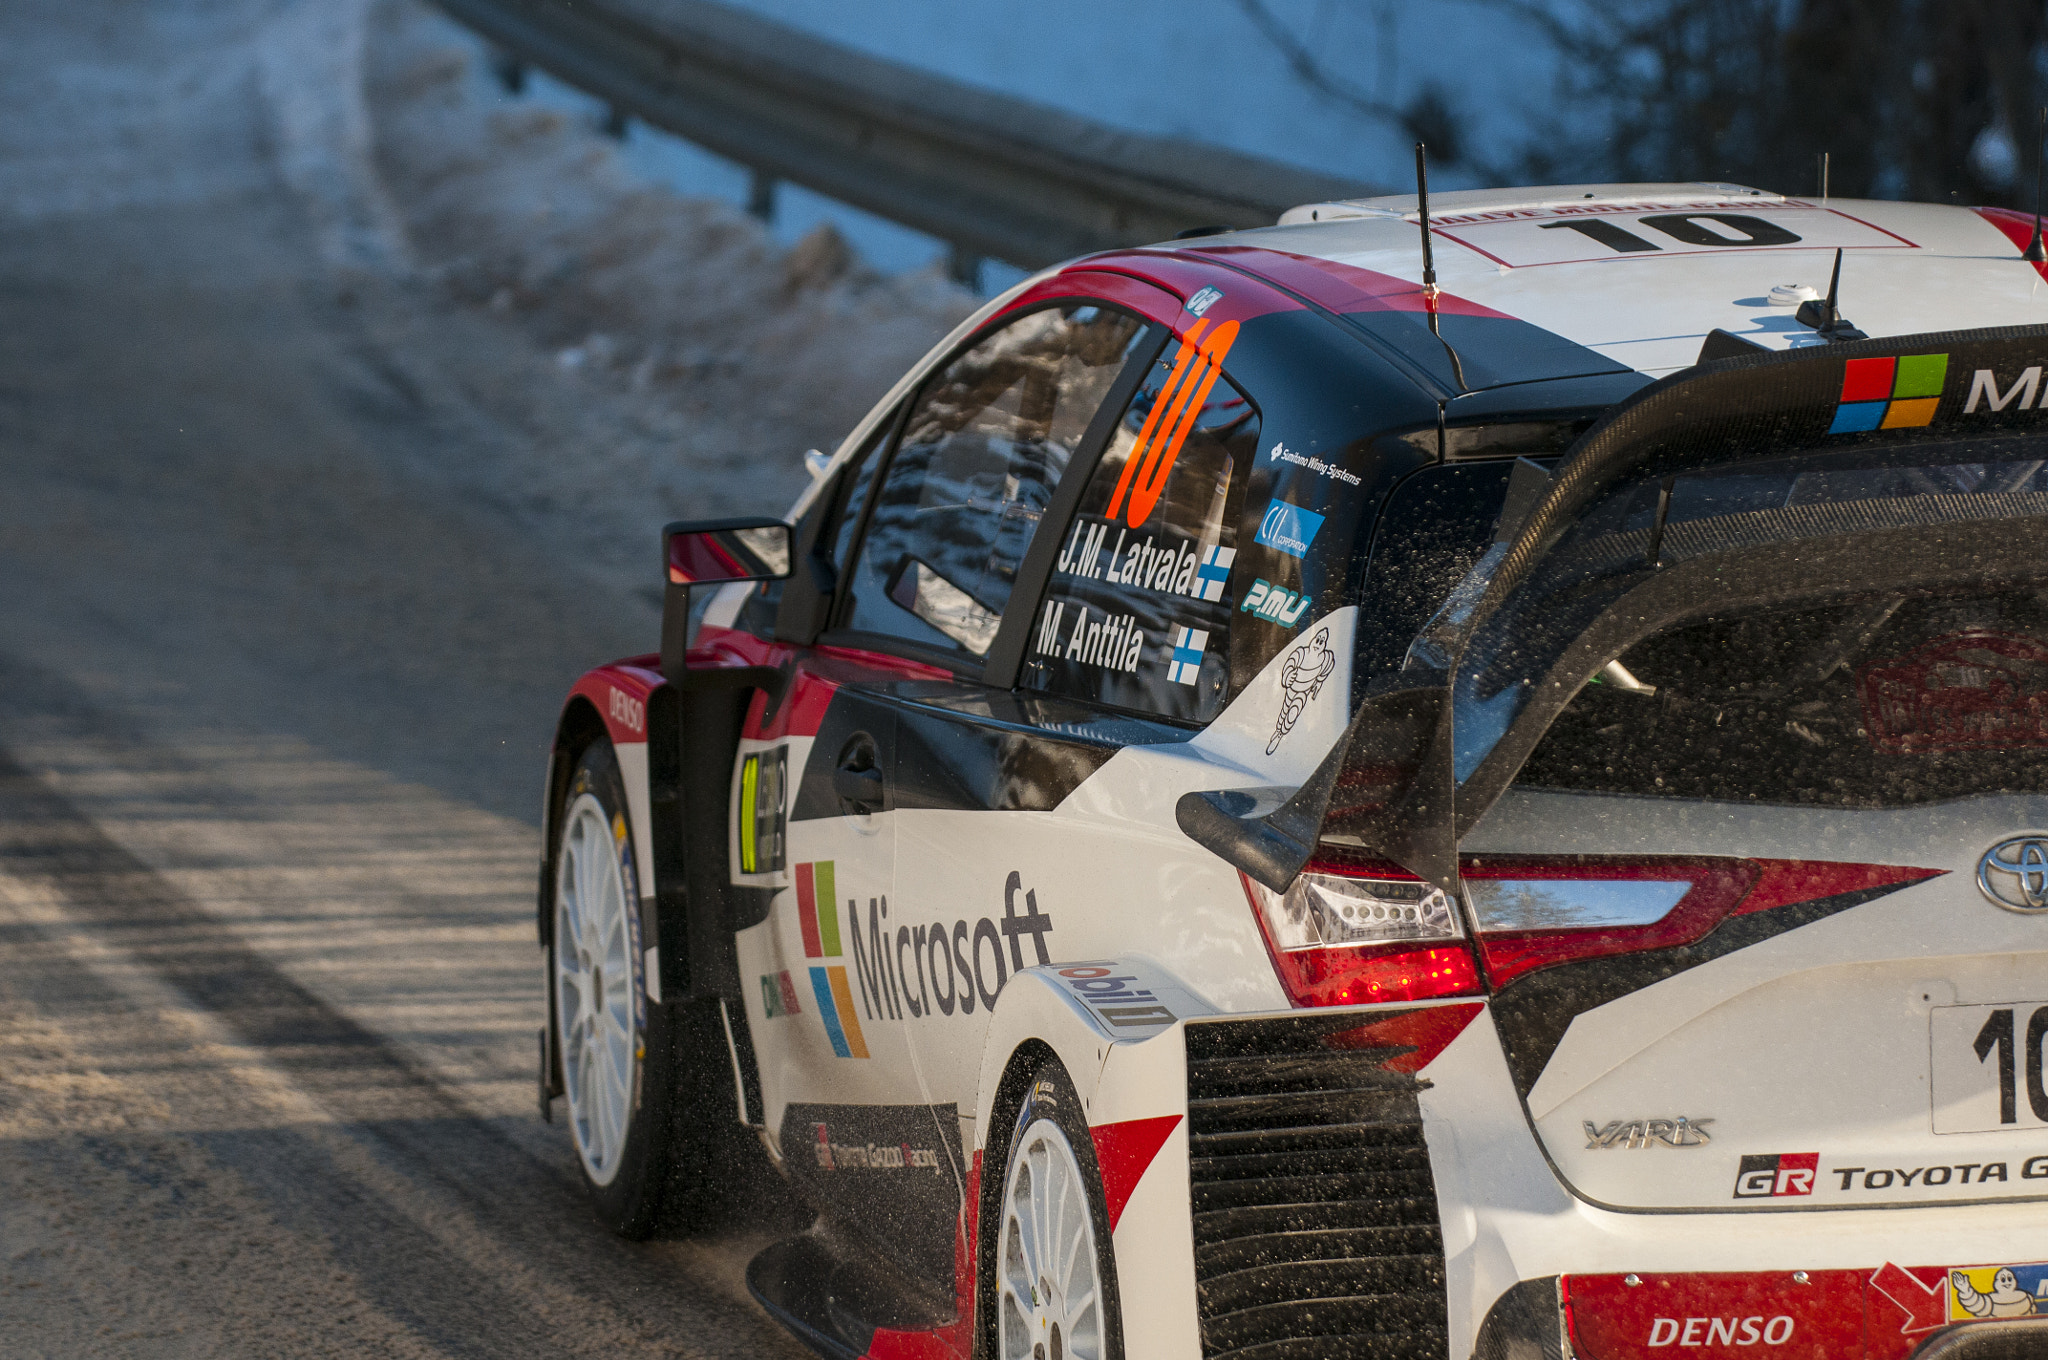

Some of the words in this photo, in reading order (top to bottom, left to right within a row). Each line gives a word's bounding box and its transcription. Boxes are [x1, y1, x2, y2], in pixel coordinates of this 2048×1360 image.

[1538, 213, 1802, 253] 10
[1962, 366, 2048, 414] M
[1105, 318, 1240, 529] 10
[1281, 449, 1309, 467] Sumitomo
[1307, 456, 1328, 476] Wiring
[1326, 463, 1362, 486] Systems
[1058, 519, 1107, 580] J.M.
[1106, 528, 1197, 596] Latvala
[1277, 535, 1308, 553] CORPORATION
[1036, 600, 1066, 658] M.
[1065, 607, 1144, 673] Anttila
[609, 685, 645, 733] DENSO
[848, 870, 1053, 1020] Microsoft
[1735, 1165, 1816, 1196] GR
[1833, 1162, 2008, 1191] TOYOTA
[1647, 1315, 1794, 1347] DENSO
